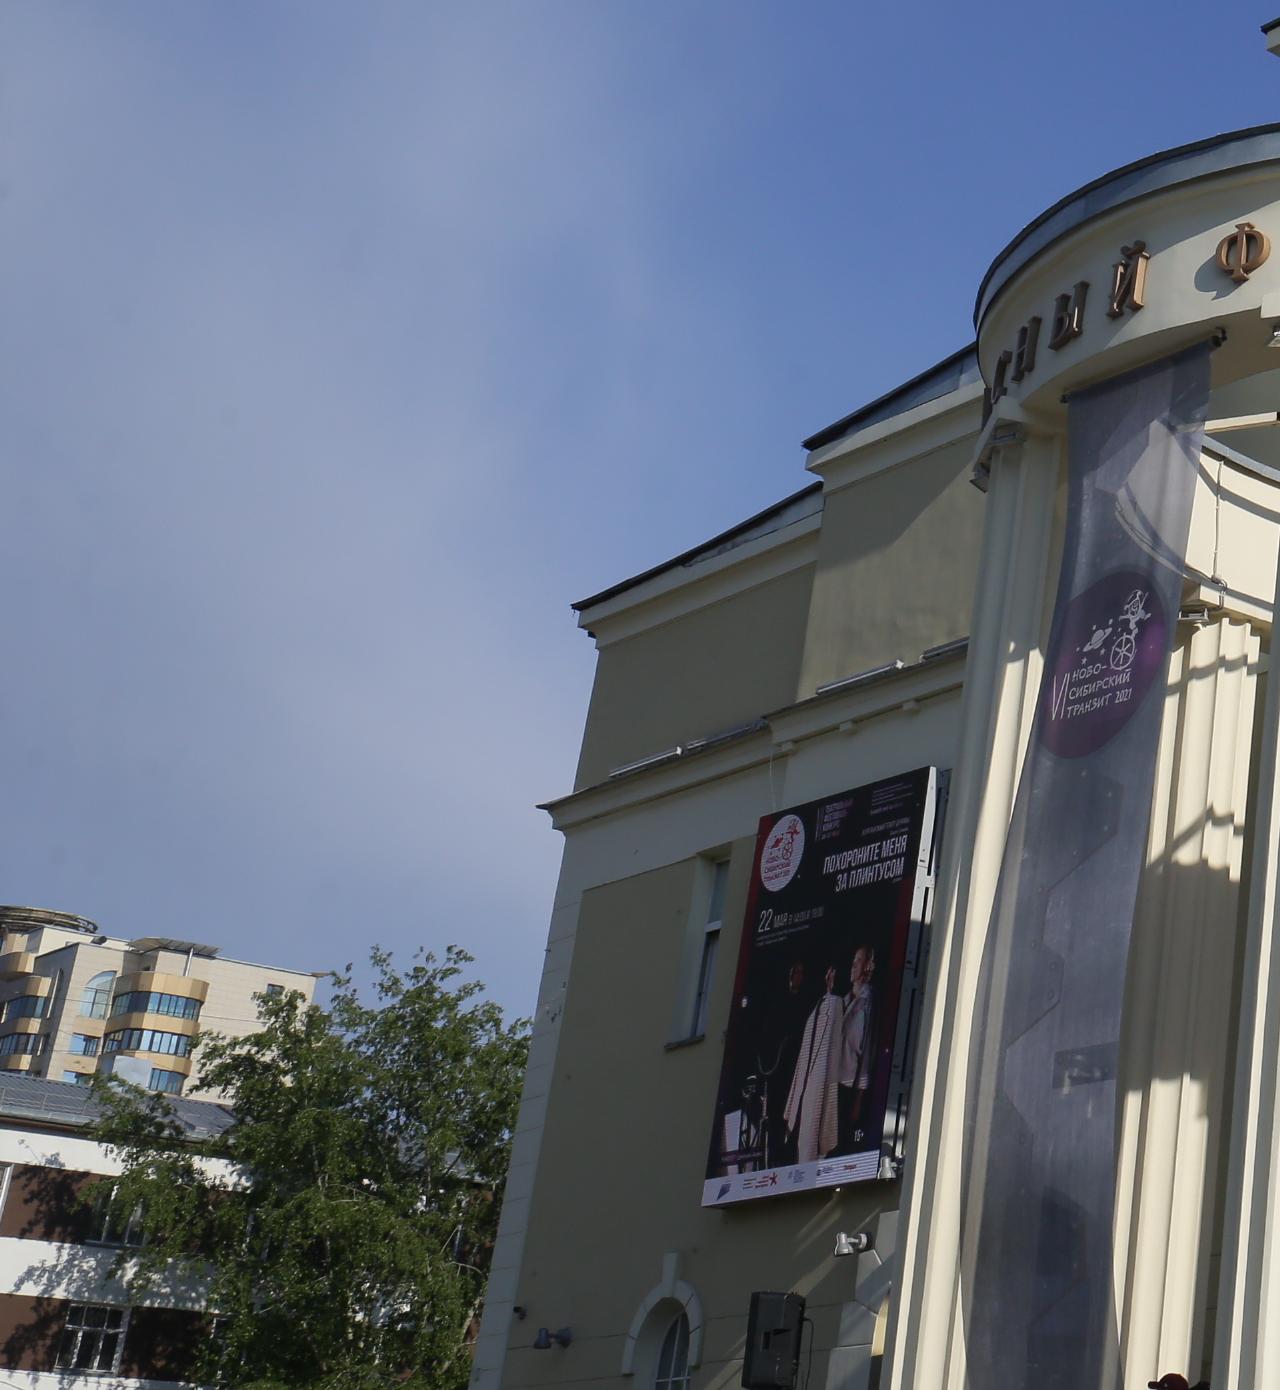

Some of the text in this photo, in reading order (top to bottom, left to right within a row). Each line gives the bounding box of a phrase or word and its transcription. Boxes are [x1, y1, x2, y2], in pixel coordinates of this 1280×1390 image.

[1068, 668, 1132, 700] СИБИРСКИЙ
[1072, 663, 1107, 682] НОВО-
[1066, 688, 1133, 719] ТРАНЗИТ 2021
[823, 842, 881, 875] ПОХОРОНИТЕ
[881, 834, 909, 858] МЕНЯ
[835, 857, 905, 892] ЗА ПЛИНТУСОМ
[758, 908, 774, 933] 22
